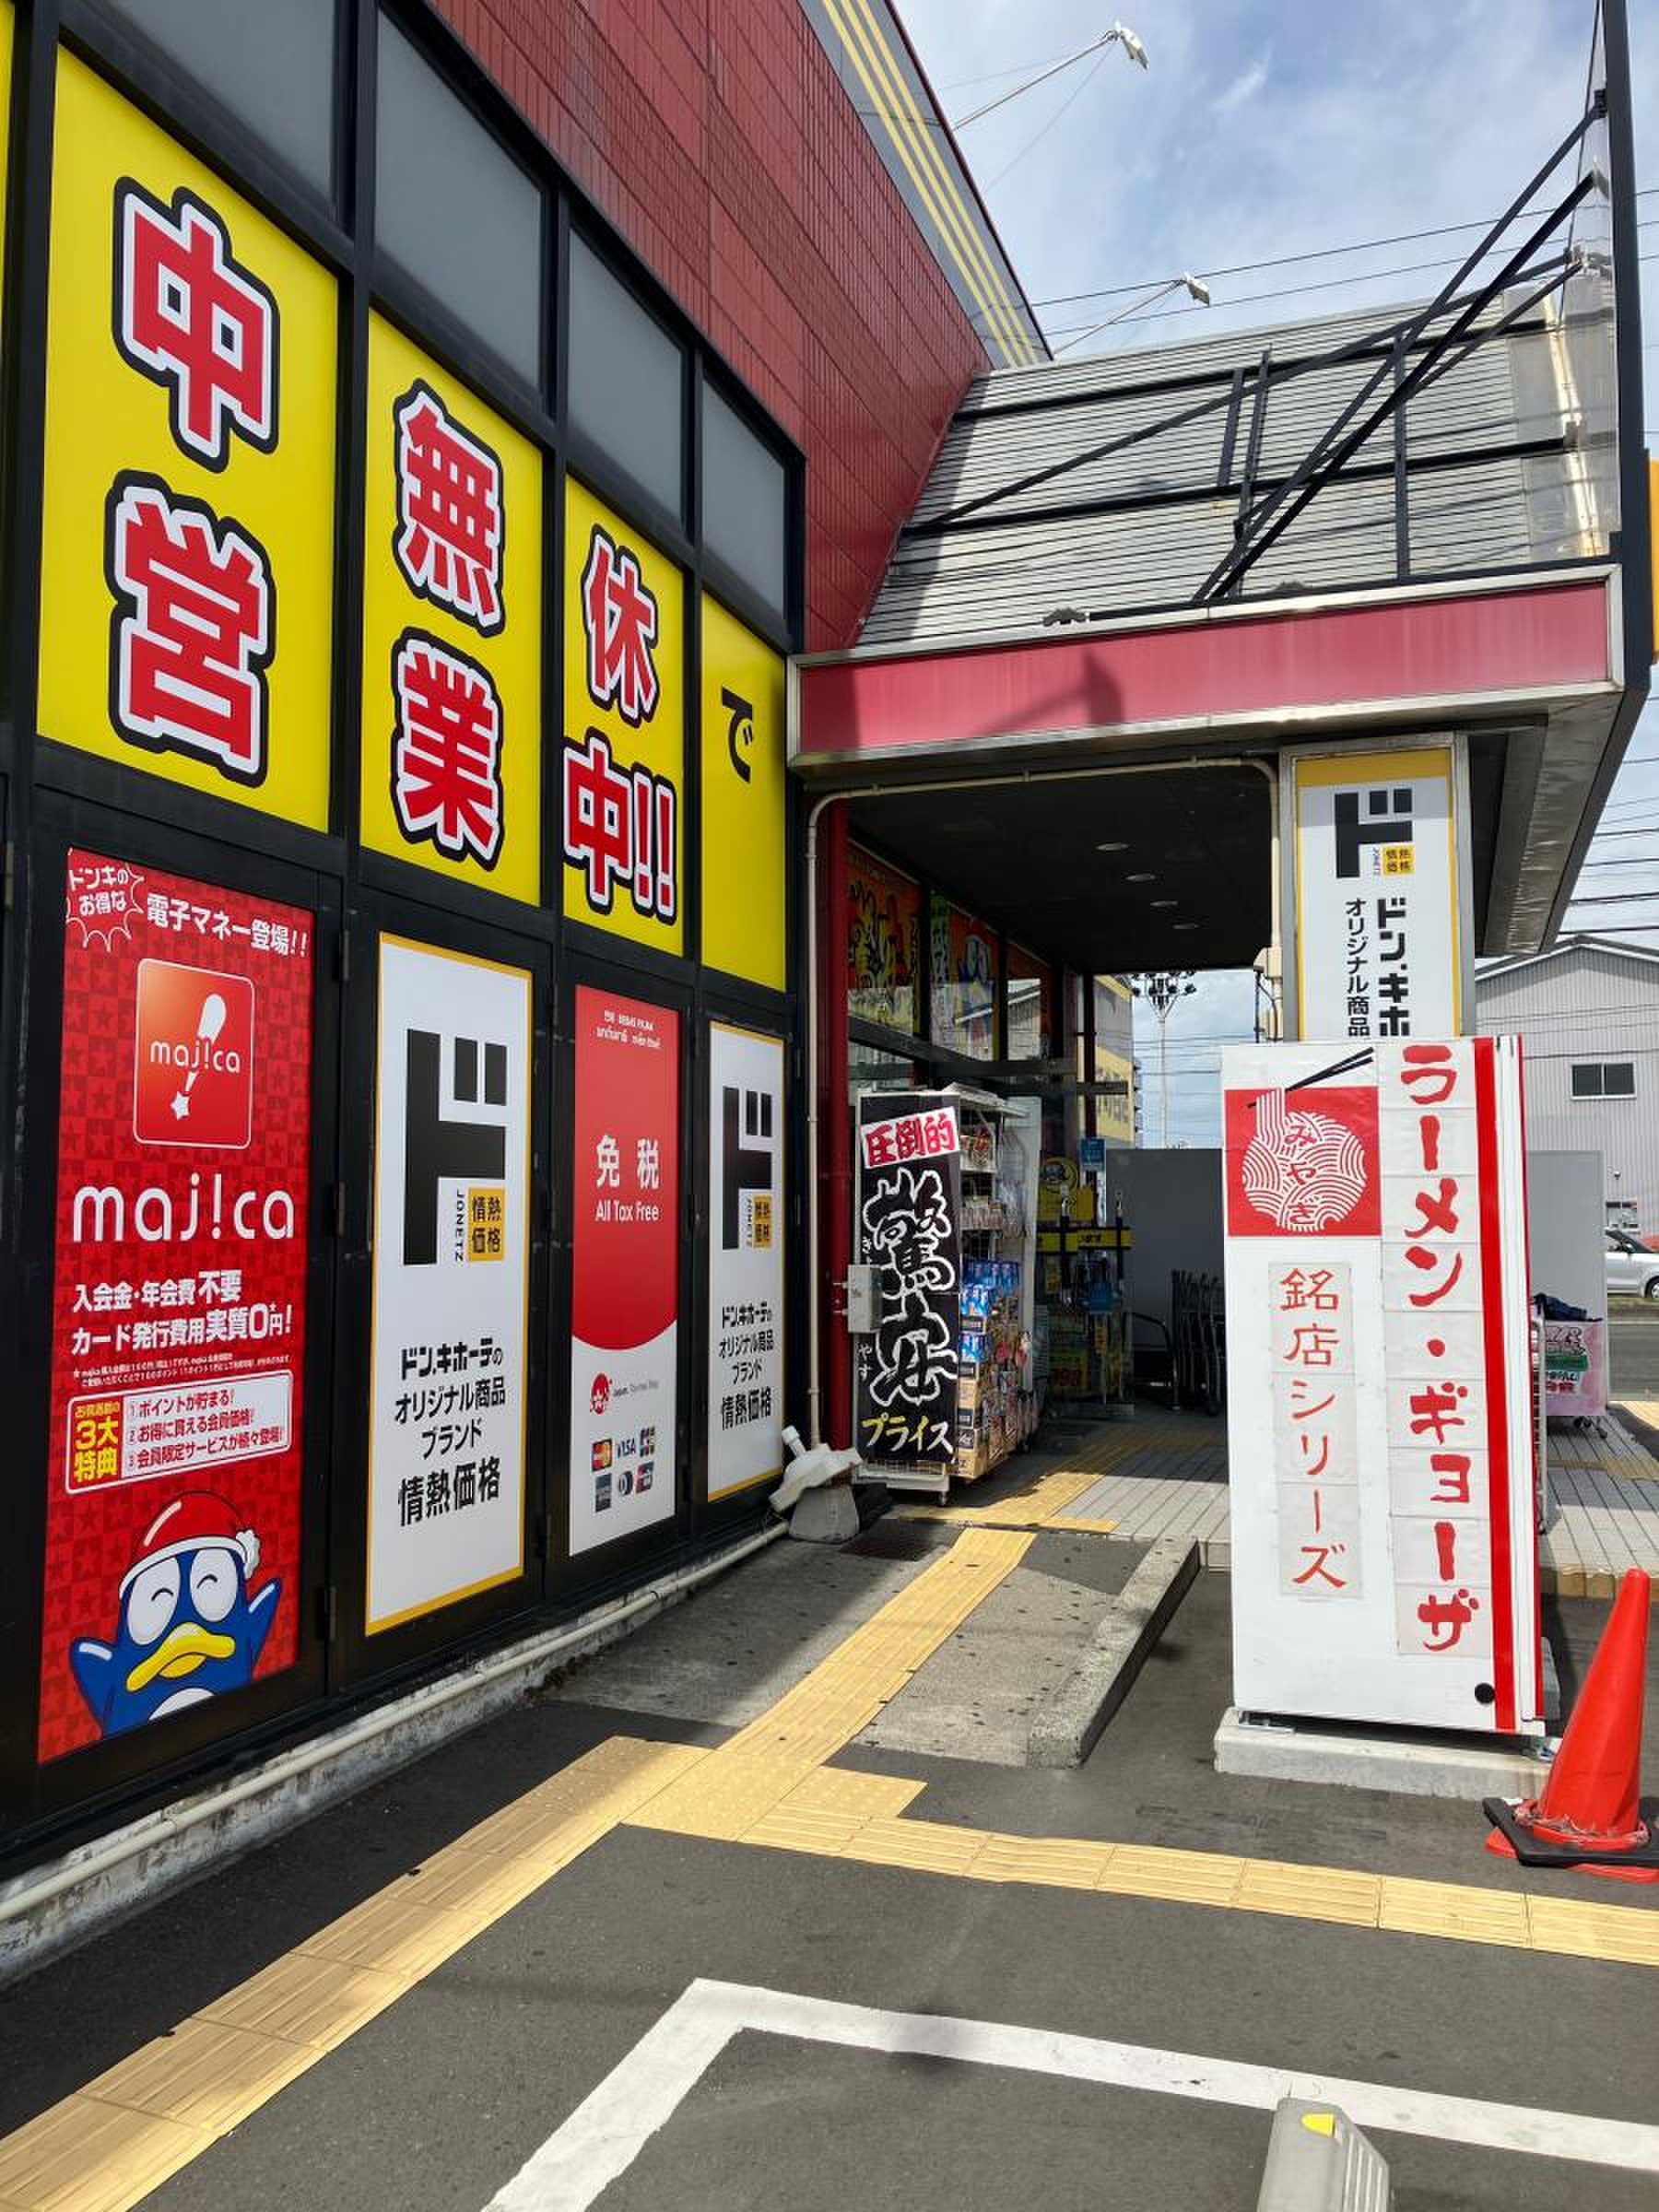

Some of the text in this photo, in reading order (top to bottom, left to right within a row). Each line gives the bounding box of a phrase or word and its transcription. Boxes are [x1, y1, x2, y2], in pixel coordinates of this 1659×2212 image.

[69, 866, 128, 891] ドンキの
[78, 890, 127, 915] お得な
[866, 1112, 957, 1168] 圧倒的
[594, 1199, 660, 1222] All Tax Free
[732, 1358, 762, 1384] ブランド
[394, 1375, 506, 1424] オリジナル商品
[421, 1417, 482, 1460] ブランド
[862, 1412, 955, 1454] プライス
[1279, 1268, 1347, 1588] 銘店シリーズ
[397, 1455, 500, 1527] 情熱価格
